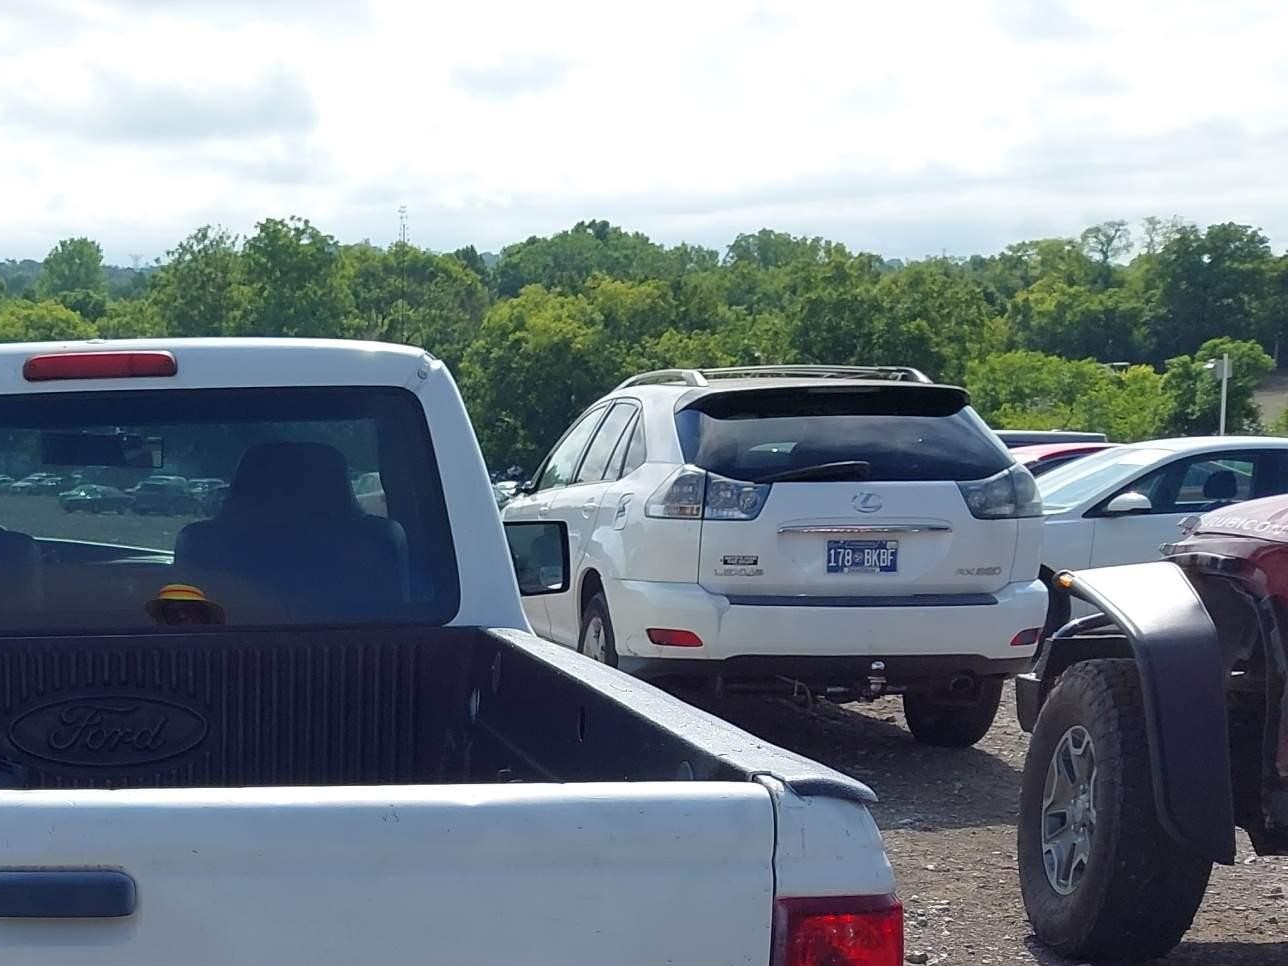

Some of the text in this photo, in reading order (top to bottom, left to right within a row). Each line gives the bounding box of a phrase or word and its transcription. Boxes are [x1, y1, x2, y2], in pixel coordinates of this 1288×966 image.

[828, 548, 896, 567] 178 BKBF
[49, 705, 168, 751] Ford
